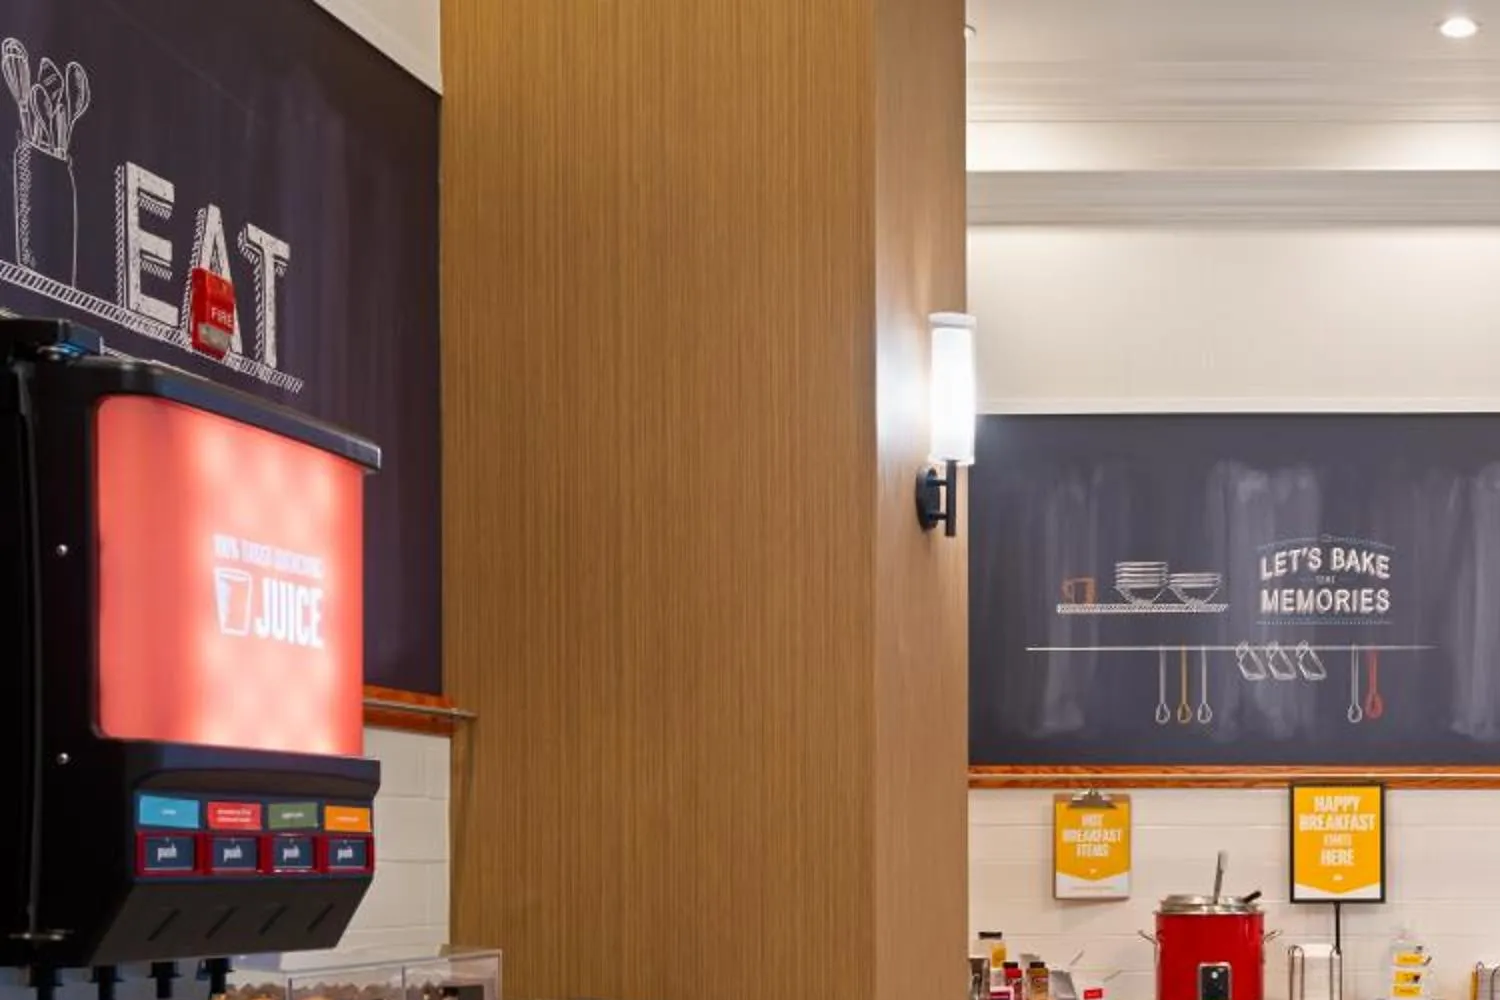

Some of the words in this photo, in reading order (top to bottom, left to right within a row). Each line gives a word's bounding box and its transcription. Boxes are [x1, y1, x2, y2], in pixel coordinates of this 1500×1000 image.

[117, 161, 291, 369] EAT
[211, 306, 234, 328] FIRE
[1260, 547, 1322, 581] LET'S
[1330, 547, 1391, 579] BAKE
[256, 576, 323, 650] JUICE
[1260, 588, 1391, 614] MEMORIES
[1314, 795, 1361, 812] HAPPY
[1299, 813, 1376, 832] BREAKFAST
